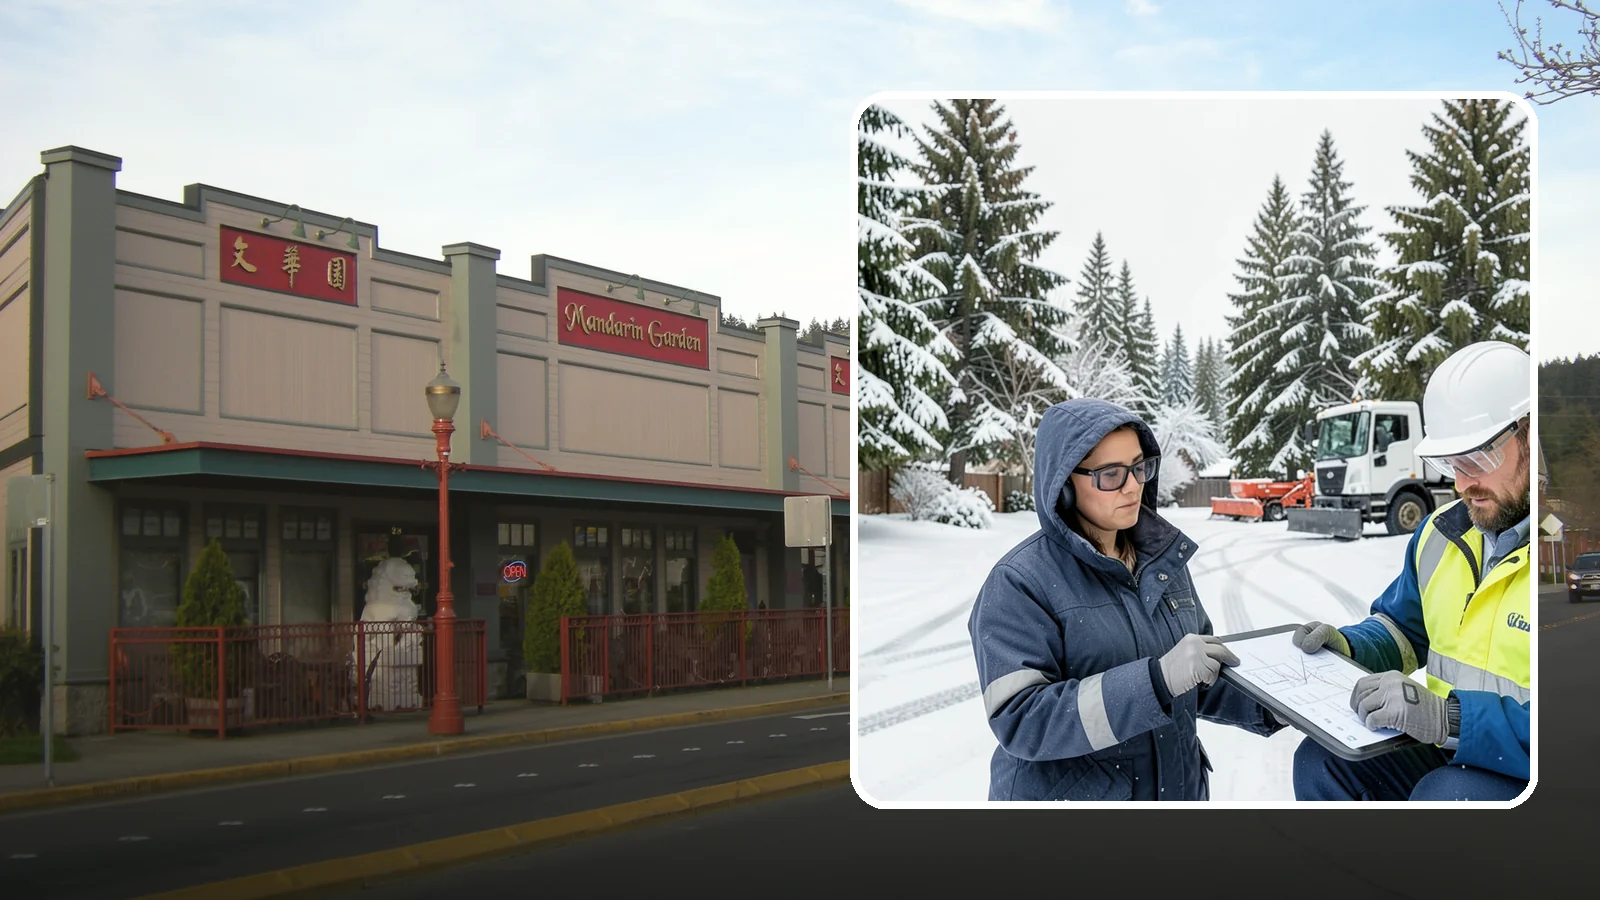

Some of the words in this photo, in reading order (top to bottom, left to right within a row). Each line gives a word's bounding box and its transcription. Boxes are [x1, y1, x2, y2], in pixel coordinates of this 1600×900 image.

[230, 235, 346, 291] 文華園
[564, 302, 644, 340] Mandarin
[647, 319, 702, 352] Garden
[835, 363, 846, 386] 文
[503, 565, 527, 578] OPEN
